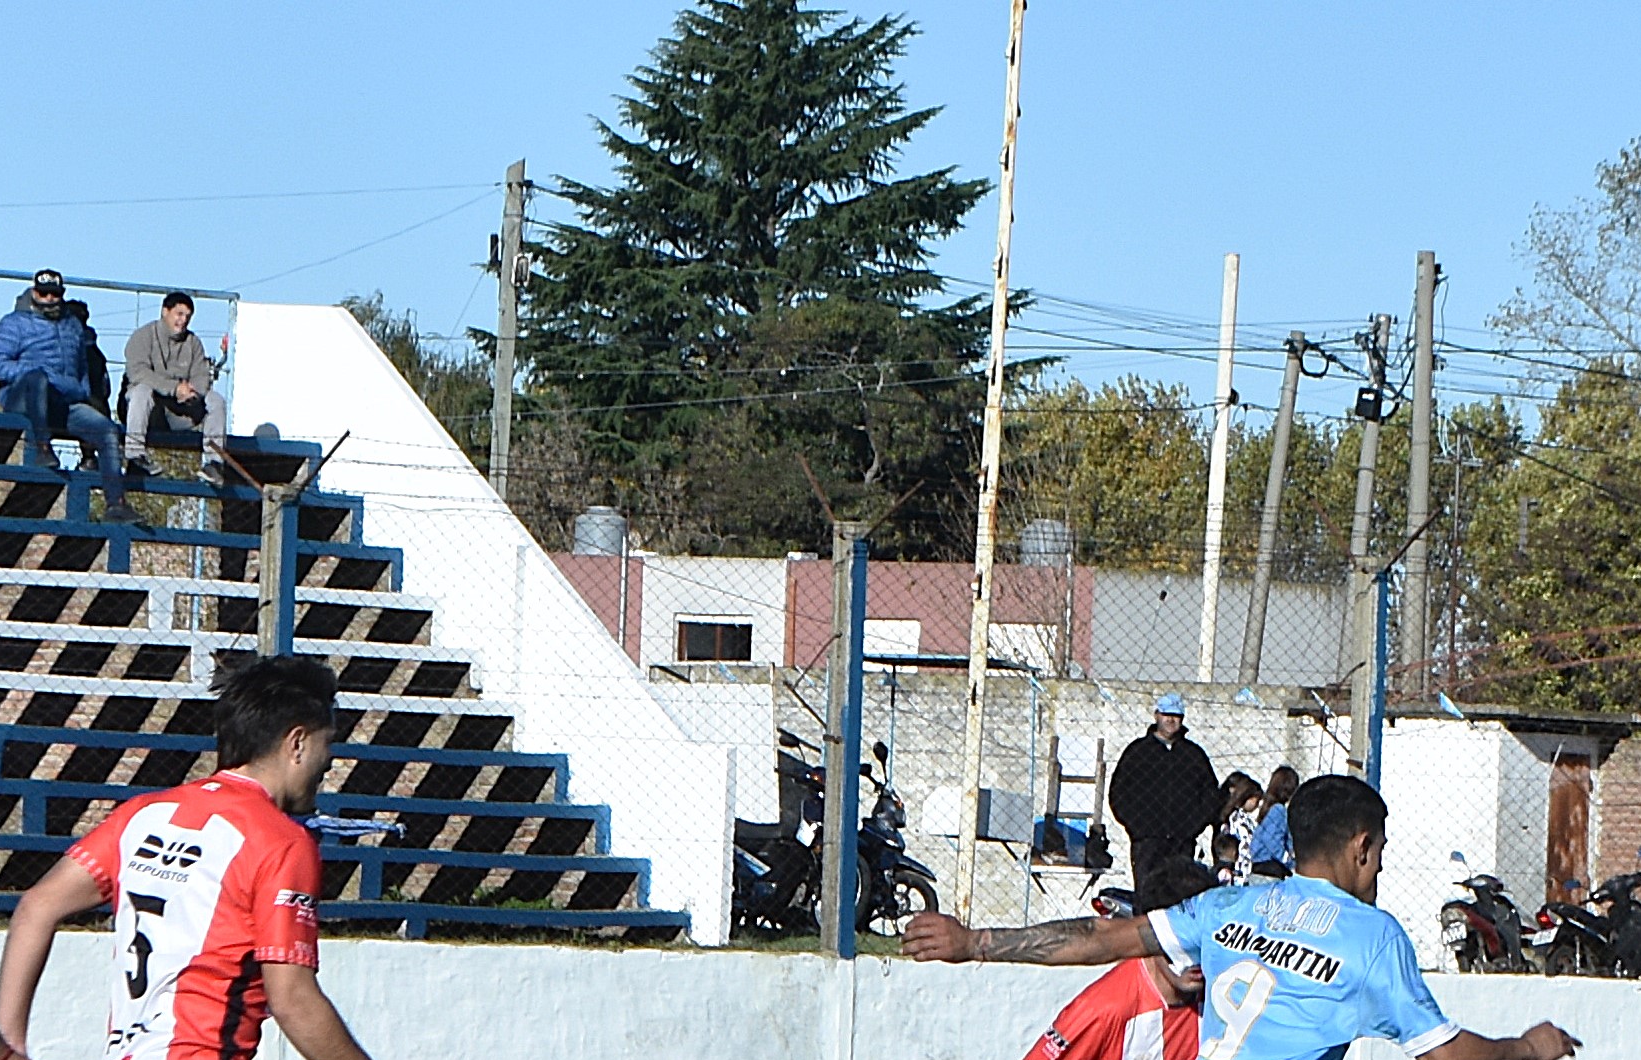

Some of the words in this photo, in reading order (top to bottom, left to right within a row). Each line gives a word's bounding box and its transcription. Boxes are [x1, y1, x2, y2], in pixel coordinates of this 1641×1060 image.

[134, 834, 202, 867] DUO
[127, 861, 189, 883] REPUESTOS
[126, 890, 168, 1000] 5
[1215, 923, 1253, 951] SAN
